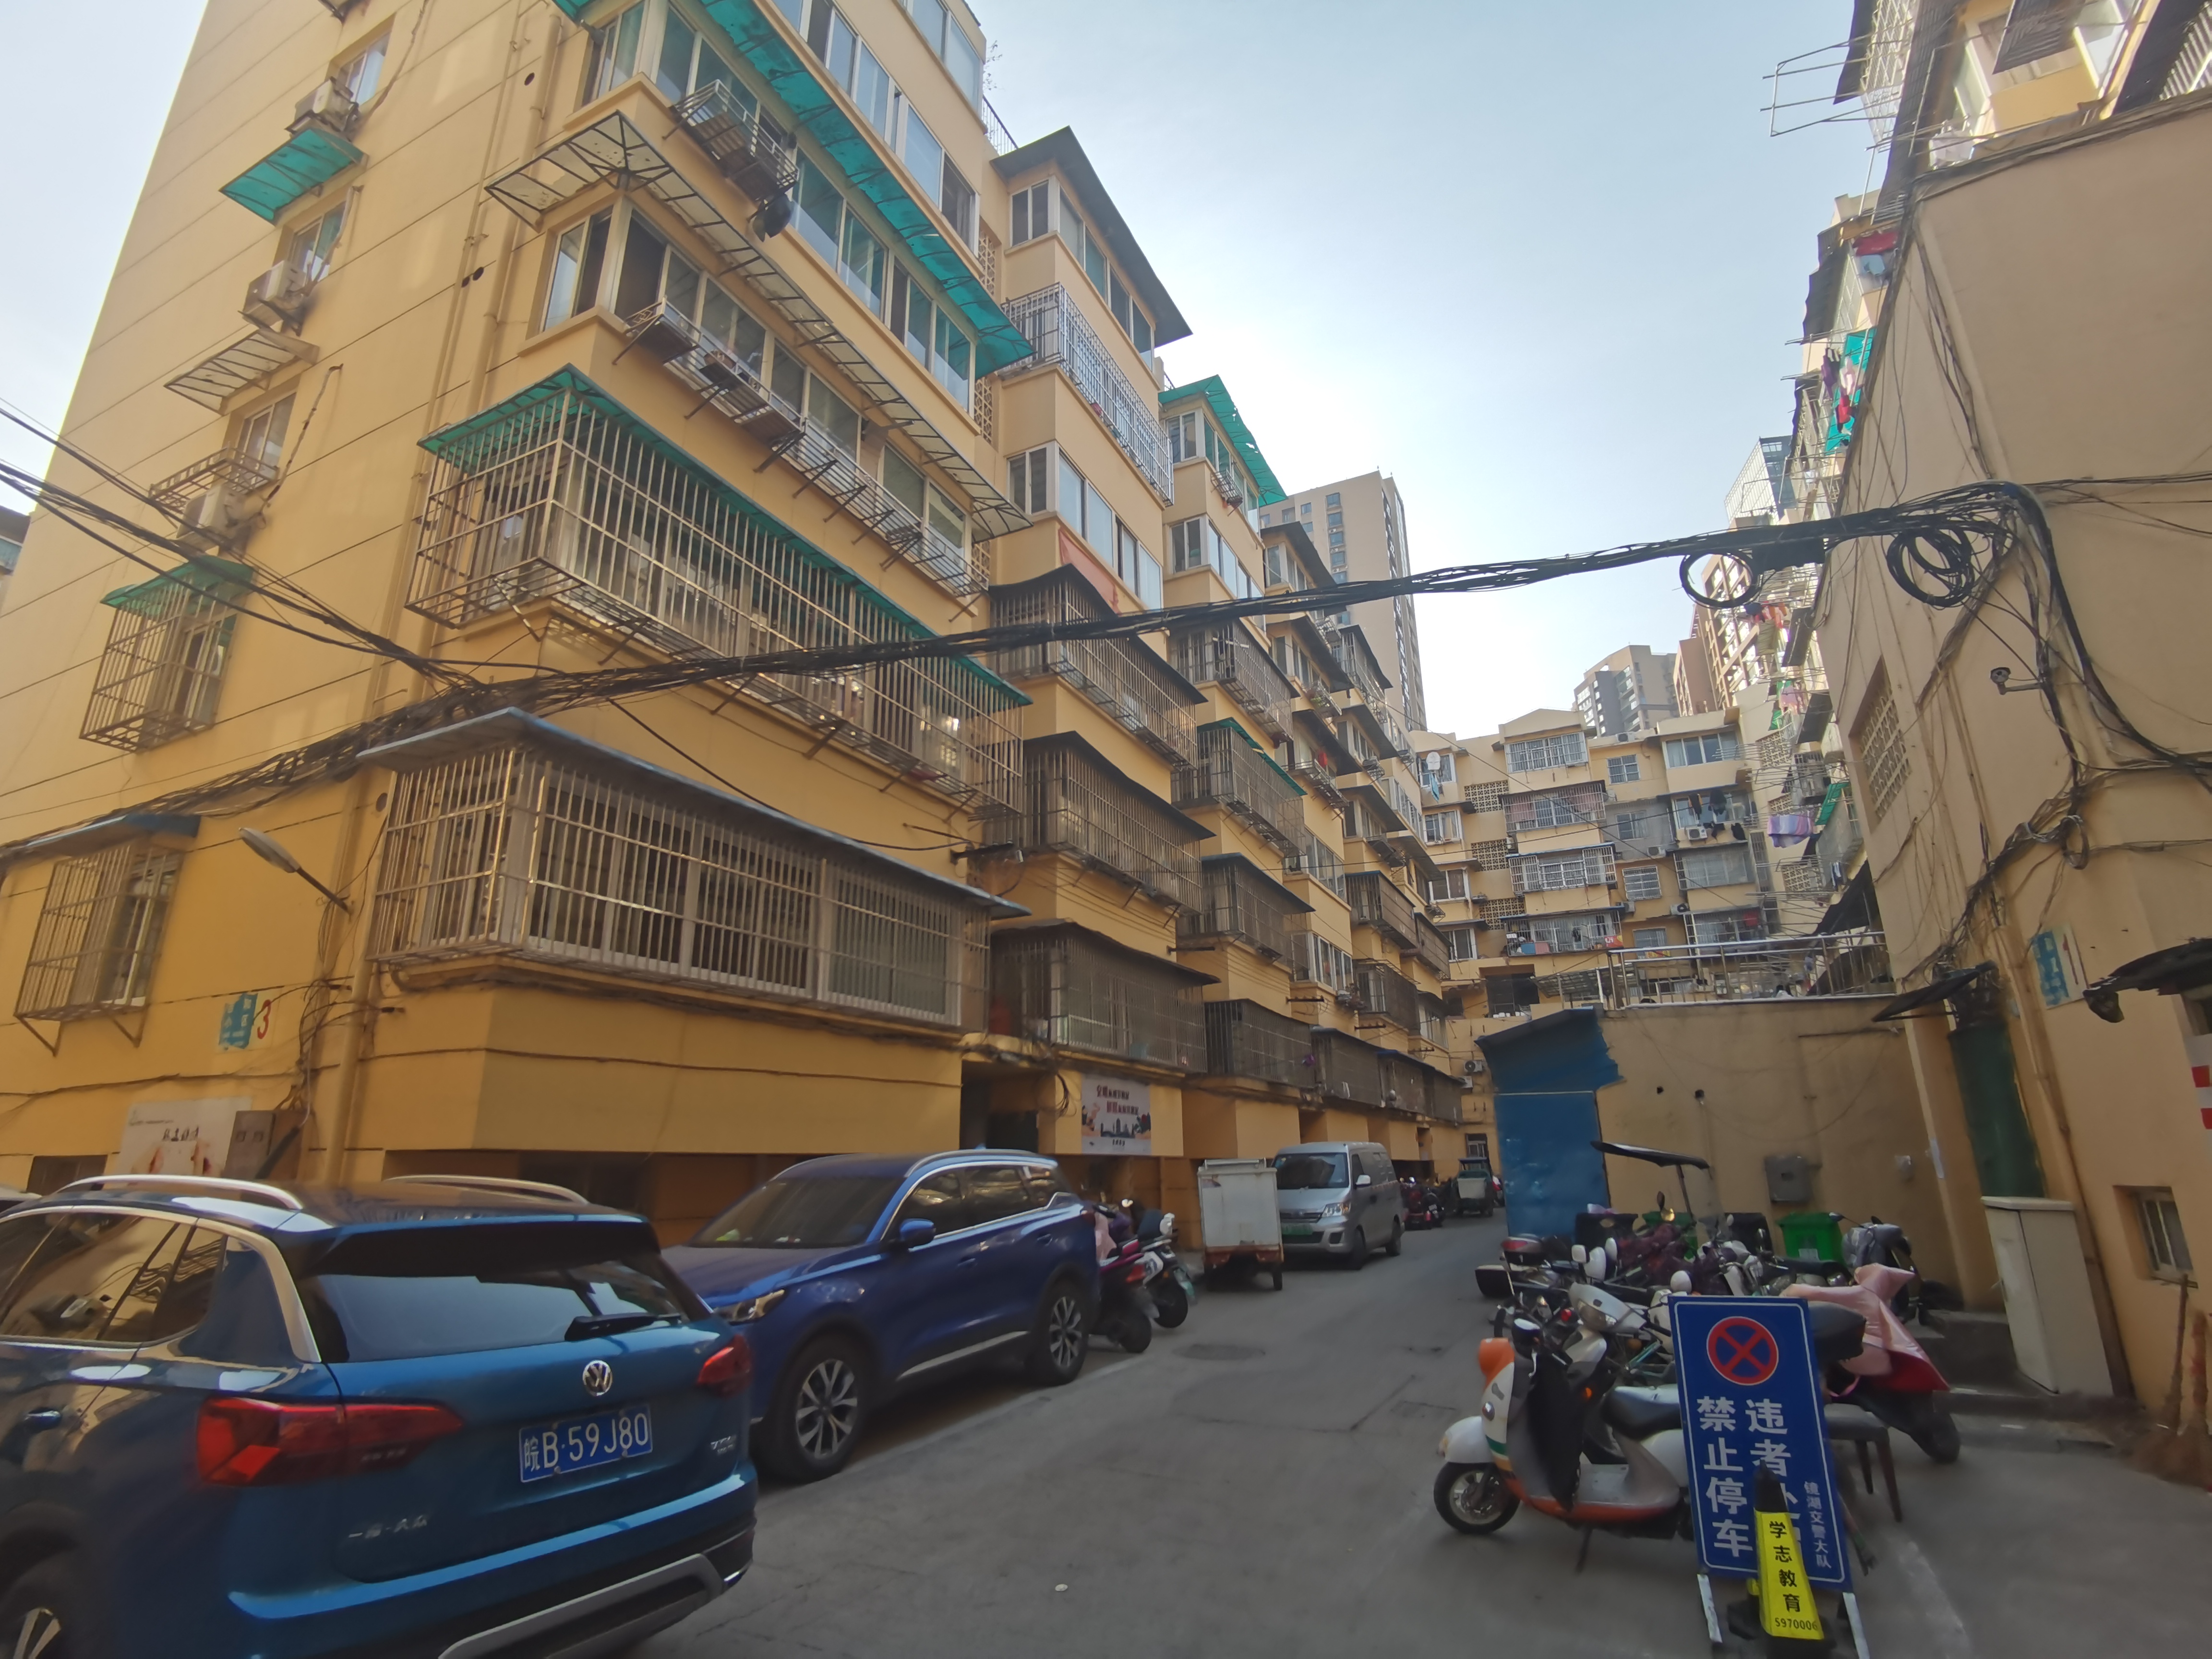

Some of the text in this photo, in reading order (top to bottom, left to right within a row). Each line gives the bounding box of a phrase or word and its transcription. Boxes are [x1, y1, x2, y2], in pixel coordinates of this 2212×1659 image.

[257, 999, 272, 1039] 3
[1696, 1396, 1753, 1557] 禁止停车
[1769, 1521, 1801, 1612] 学志教育
[1774, 1617, 1818, 1631] 5970006
